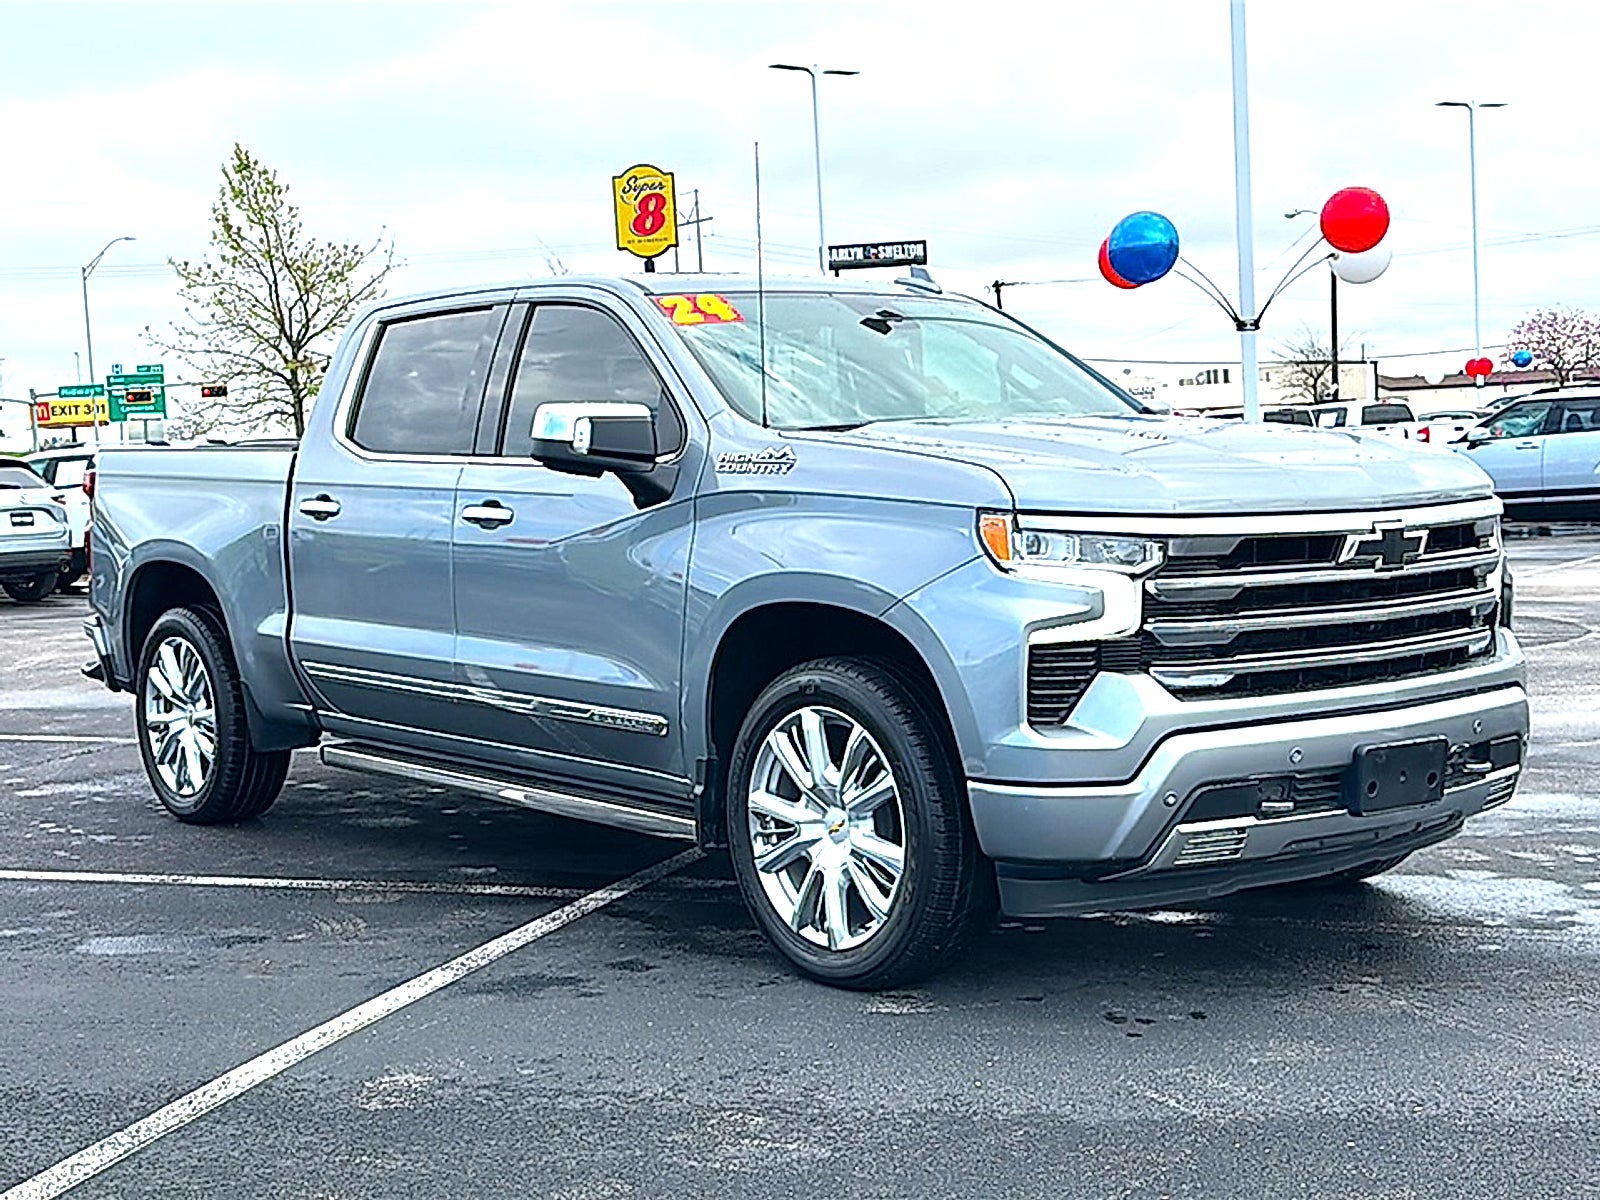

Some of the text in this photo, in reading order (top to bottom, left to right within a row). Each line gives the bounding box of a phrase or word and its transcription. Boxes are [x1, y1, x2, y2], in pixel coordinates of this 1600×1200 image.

[621, 175, 666, 201] Super
[629, 192, 667, 237] 8
[877, 243, 924, 260] SHELTON
[51, 404, 80, 417] EXIT
[715, 463, 791, 475] COUNTRY
